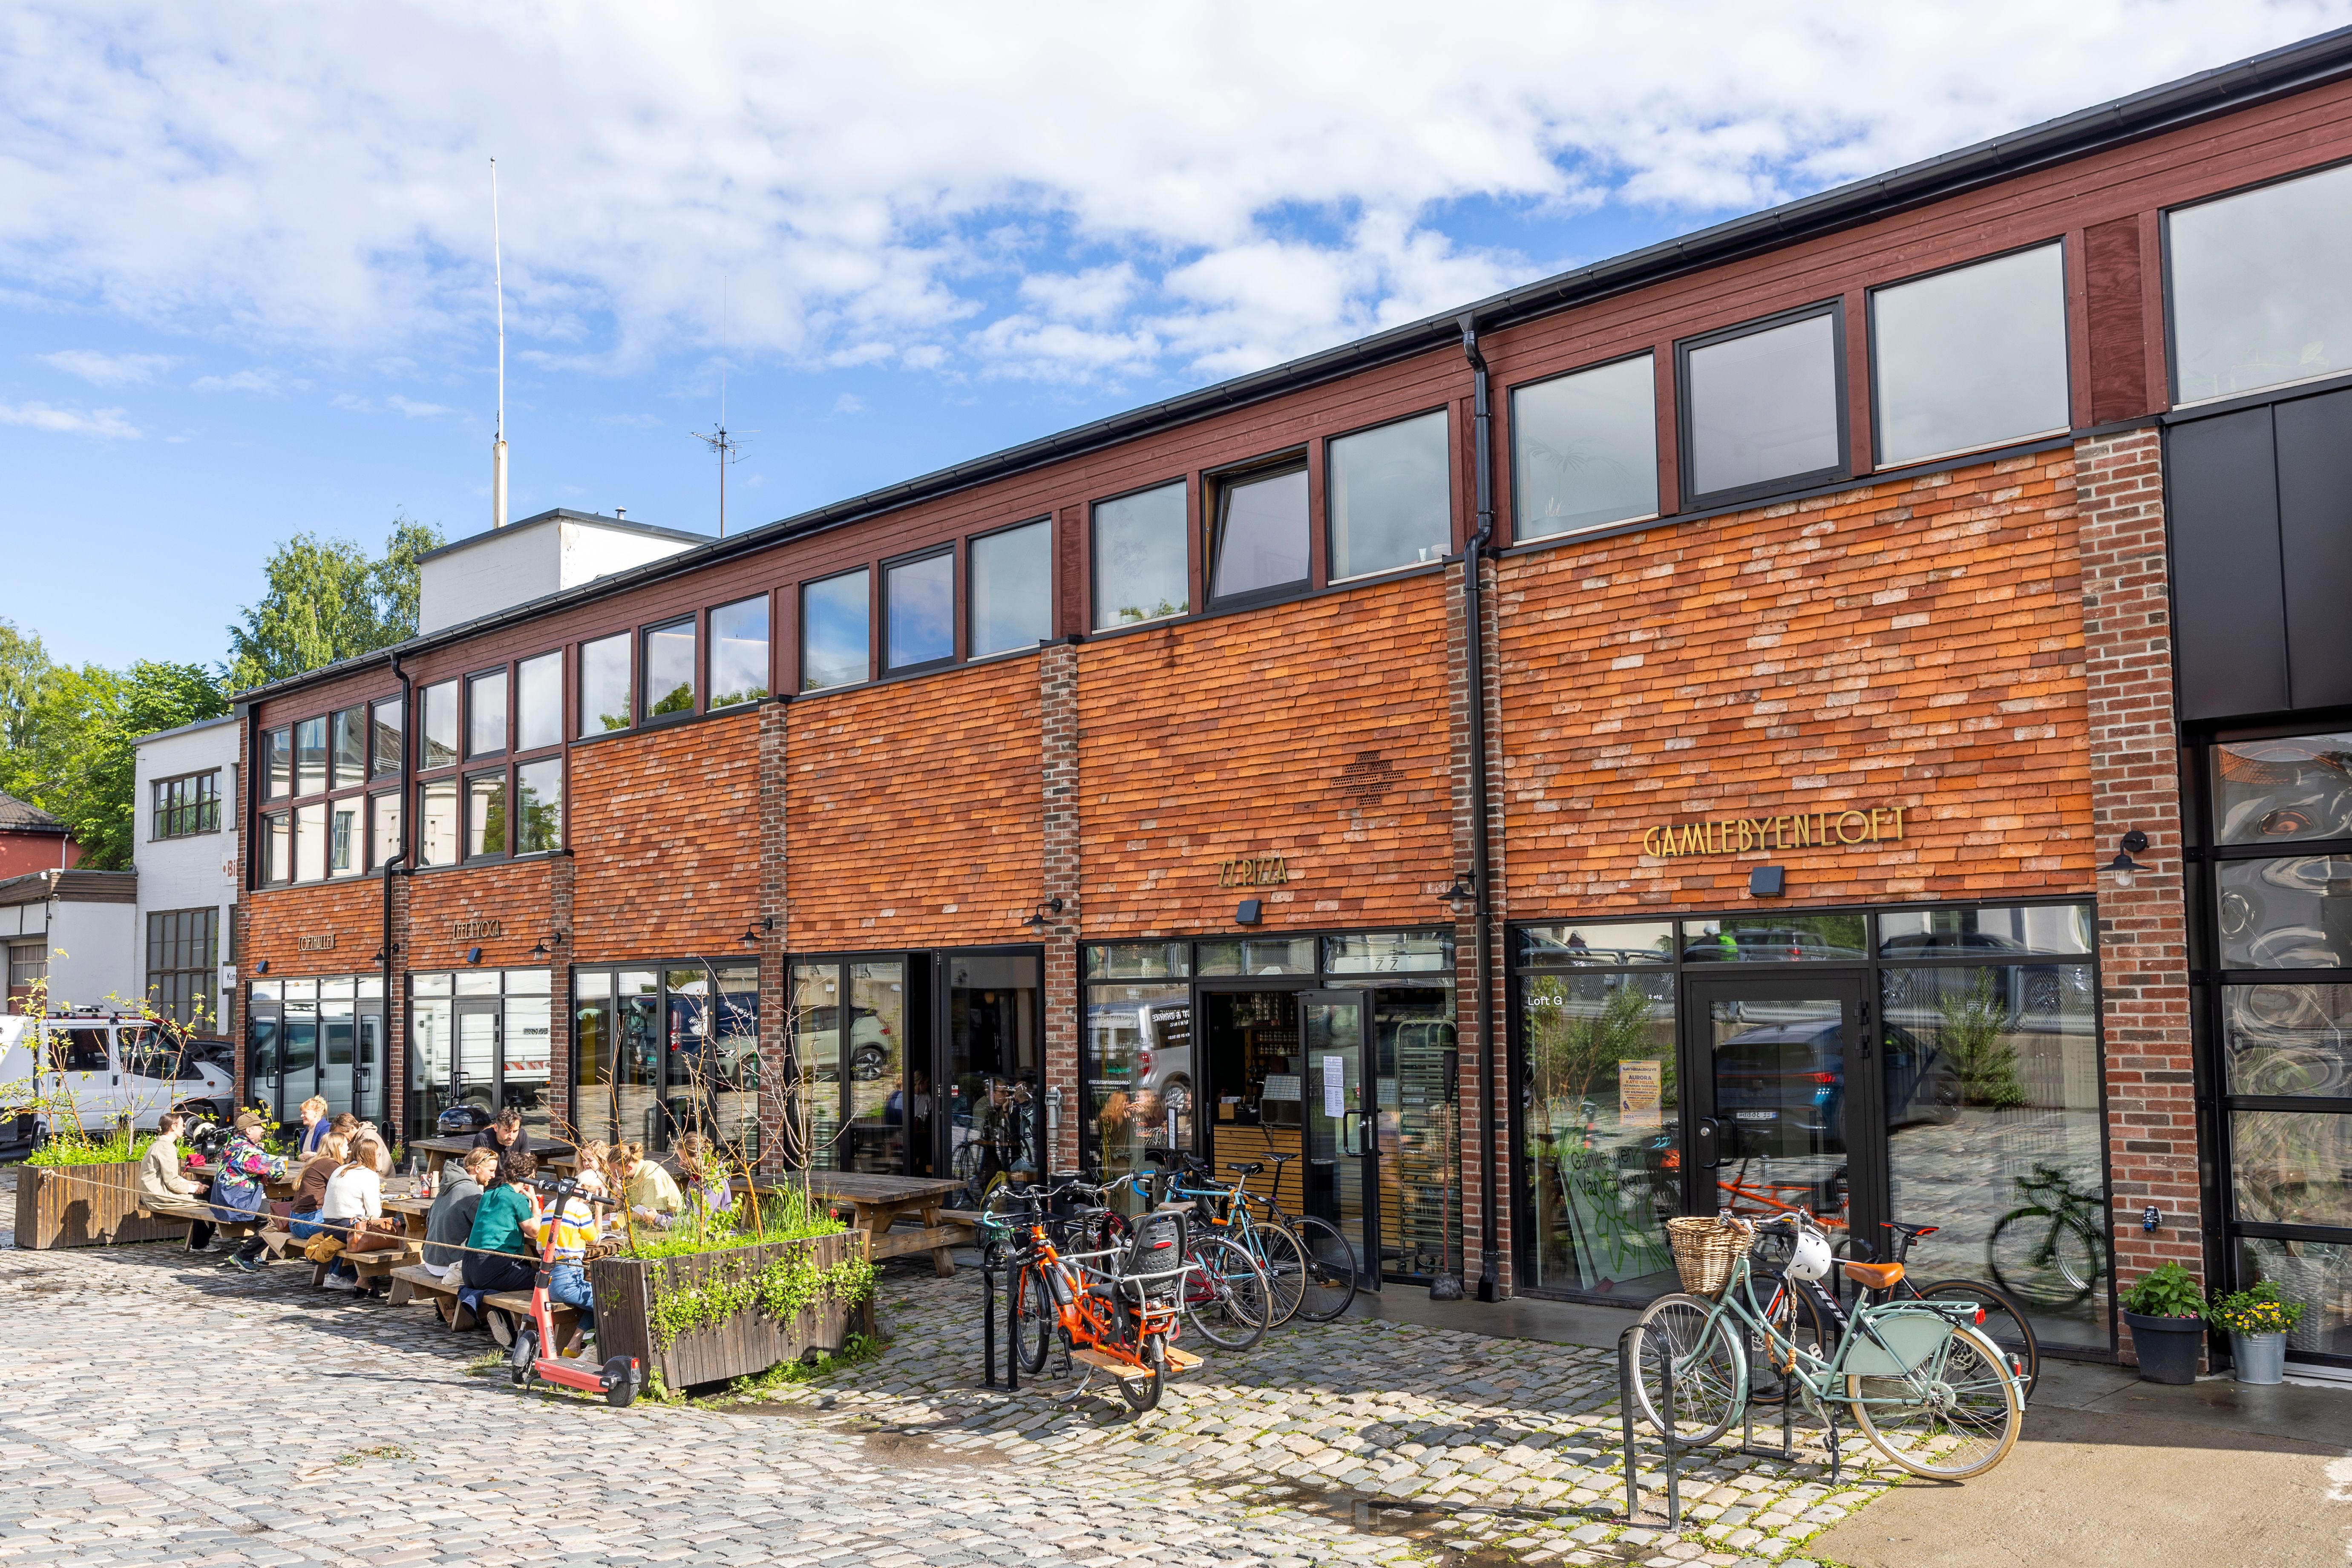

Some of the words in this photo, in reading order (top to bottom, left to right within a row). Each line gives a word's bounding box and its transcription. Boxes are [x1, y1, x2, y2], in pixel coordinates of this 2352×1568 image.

[1644, 814, 1810, 857] GAMLEBYEN
[1820, 806, 1907, 846] LOFT
[1218, 861, 1236, 887] ZZ
[1243, 857, 1287, 886] PIZZA
[453, 922, 474, 940] LEELA
[475, 920, 499, 938] YOGA
[299, 934, 334, 951] LOFTHALLEN
[1528, 996, 1550, 1005] Loft
[1553, 995, 1562, 1005] G
